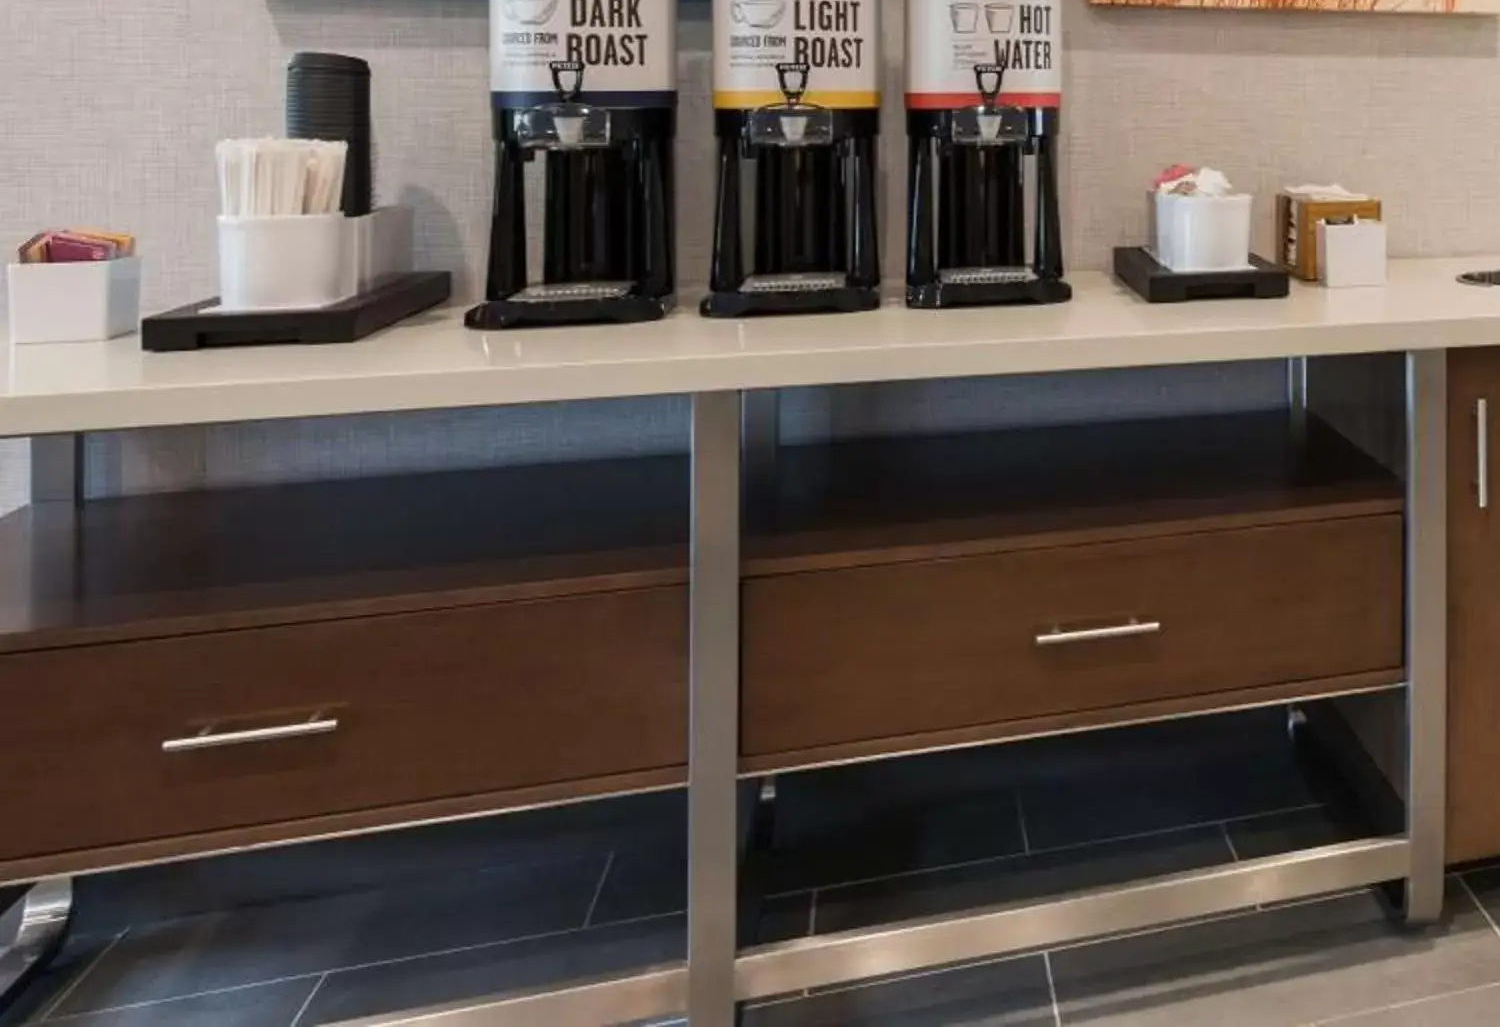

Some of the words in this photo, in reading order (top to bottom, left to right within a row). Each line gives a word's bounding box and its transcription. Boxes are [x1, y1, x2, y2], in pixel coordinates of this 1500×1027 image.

[793, 0, 861, 32] LIGHT
[1019, 4, 1052, 35] HOT
[566, 33, 648, 66] ROAST
[793, 36, 864, 69] ROAST
[993, 39, 1052, 70] WATER
